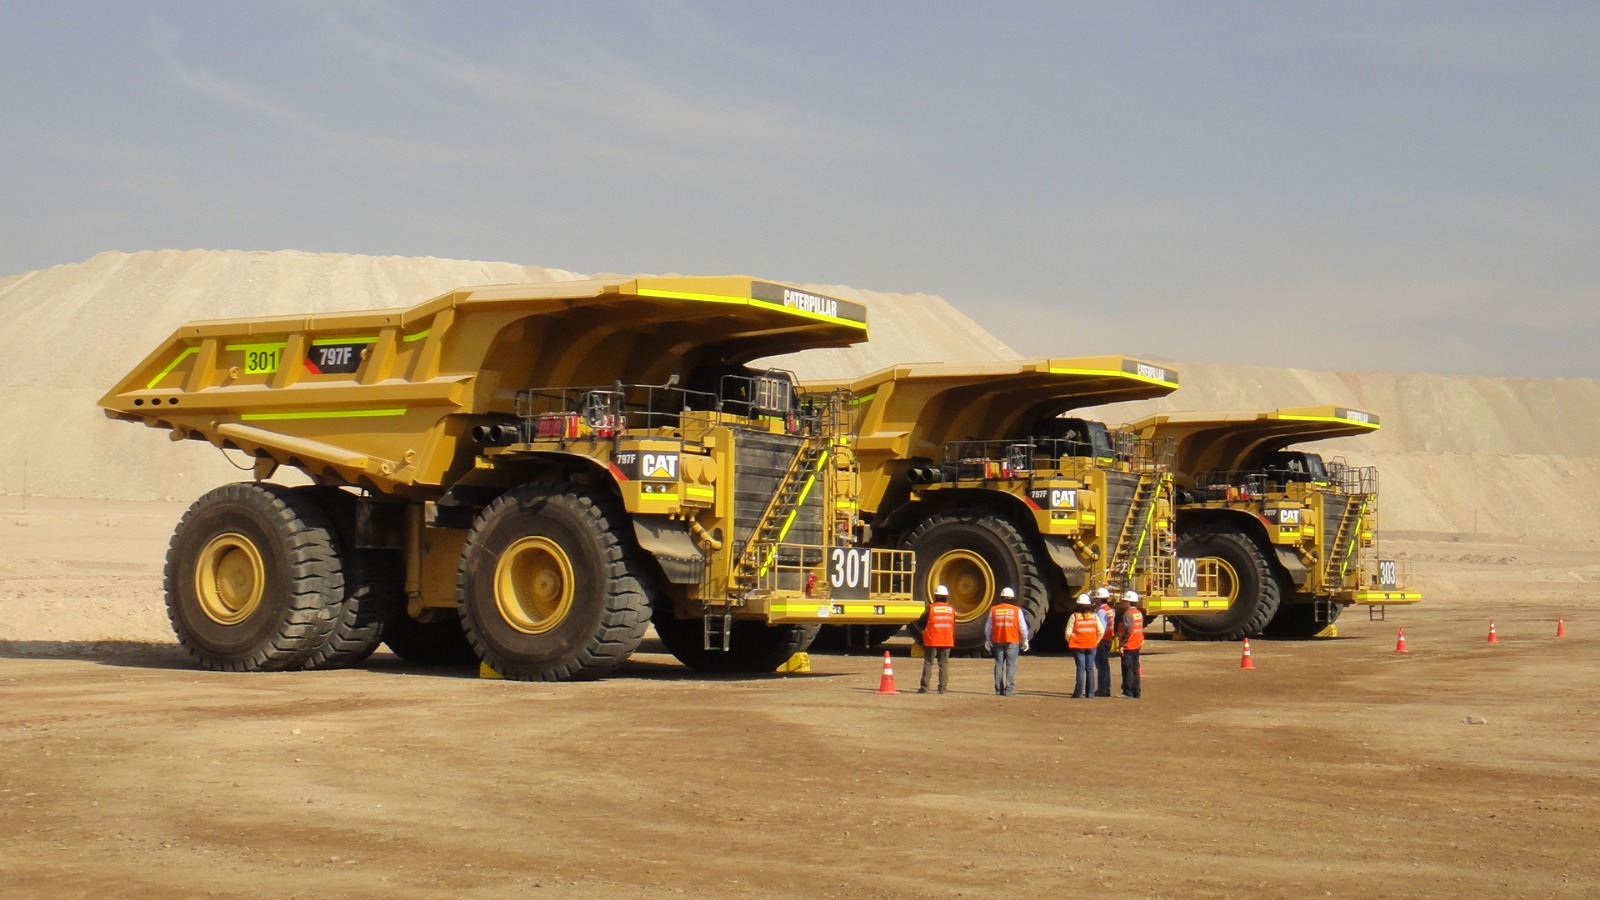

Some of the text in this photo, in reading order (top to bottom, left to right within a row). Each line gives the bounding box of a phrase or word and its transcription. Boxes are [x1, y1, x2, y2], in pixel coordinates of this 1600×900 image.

[783, 289, 838, 318] CATERPILLAR
[248, 351, 276, 372] 301
[319, 347, 353, 366] 797F
[616, 454, 636, 465] 797F
[642, 454, 678, 478] CAT
[1031, 490, 1048, 499] 797F
[1052, 490, 1076, 507] CAT
[1280, 509, 1299, 523] CAT
[831, 548, 870, 588] 301
[1177, 558, 1197, 588] 302
[1380, 561, 1395, 585] 303
